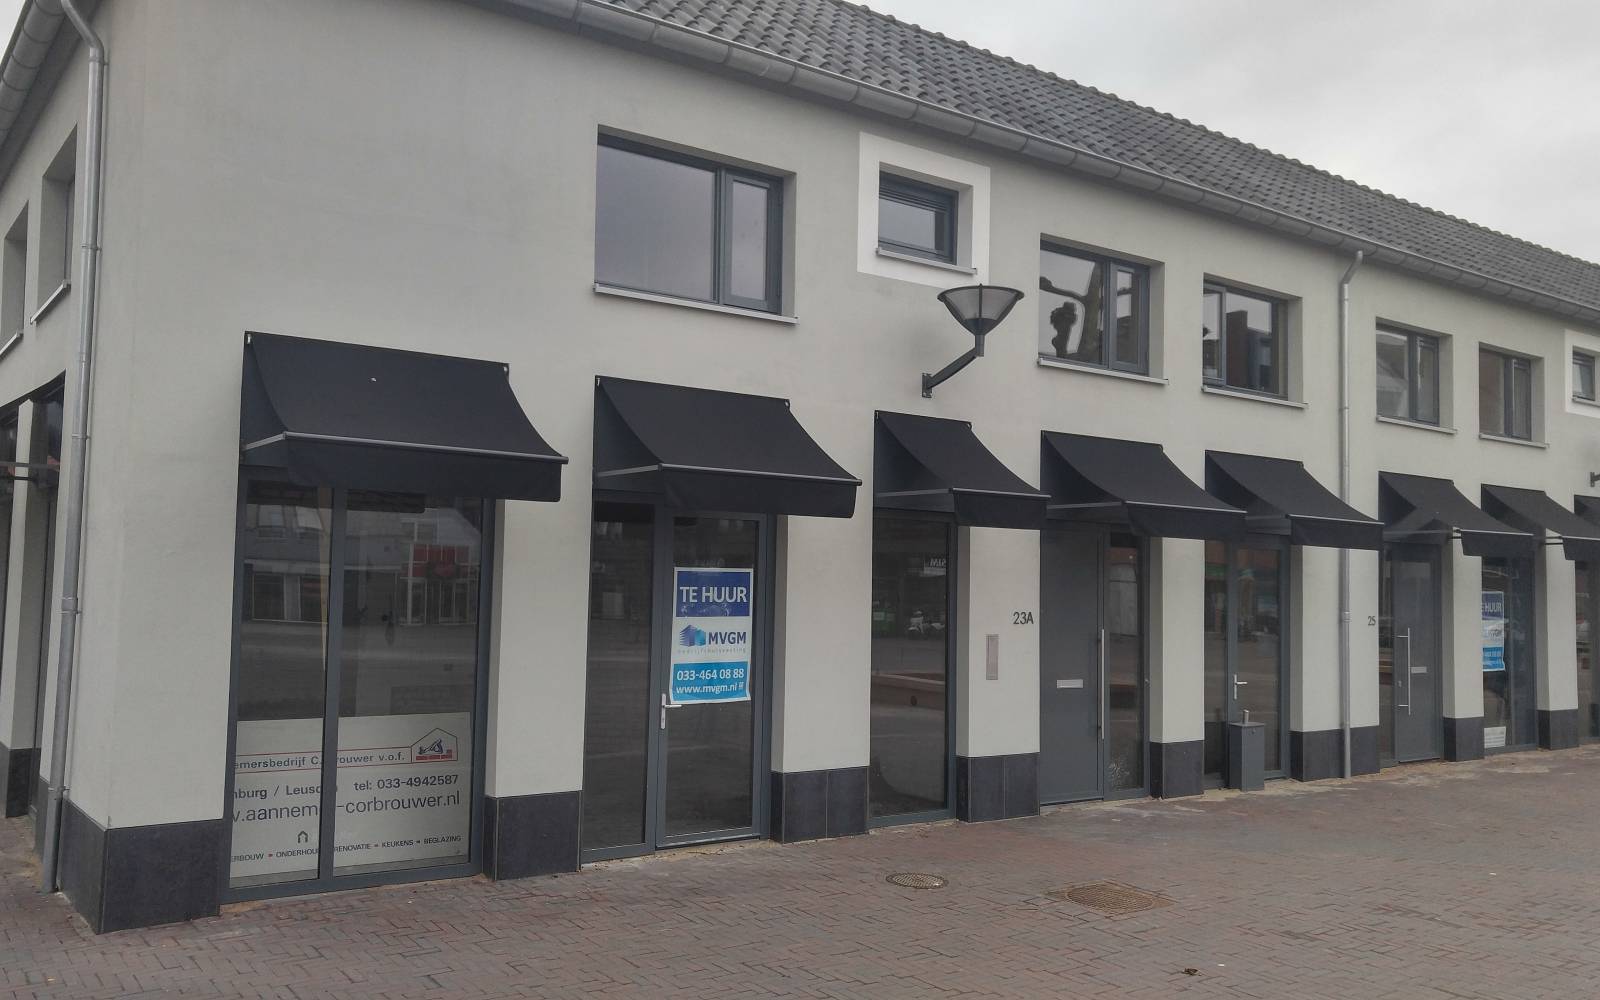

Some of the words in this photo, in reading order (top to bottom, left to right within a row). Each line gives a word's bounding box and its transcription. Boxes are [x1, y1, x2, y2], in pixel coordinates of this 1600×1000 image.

[680, 587, 698, 602] TE
[702, 587, 747, 602] HUUR
[1013, 612, 1034, 625] 23A
[1368, 616, 1376, 626] 25
[708, 632, 746, 645] MVGM
[677, 669, 717, 681] 033-464
[720, 669, 731, 680] 08
[733, 668, 744, 678] 88
[676, 683, 737, 695] www.mvgm.nl
[379, 752, 405, 761] v.o.f.
[354, 782, 372, 791] tel:
[377, 775, 458, 790] 033-4942587
[381, 840, 414, 848] KEUKENS
